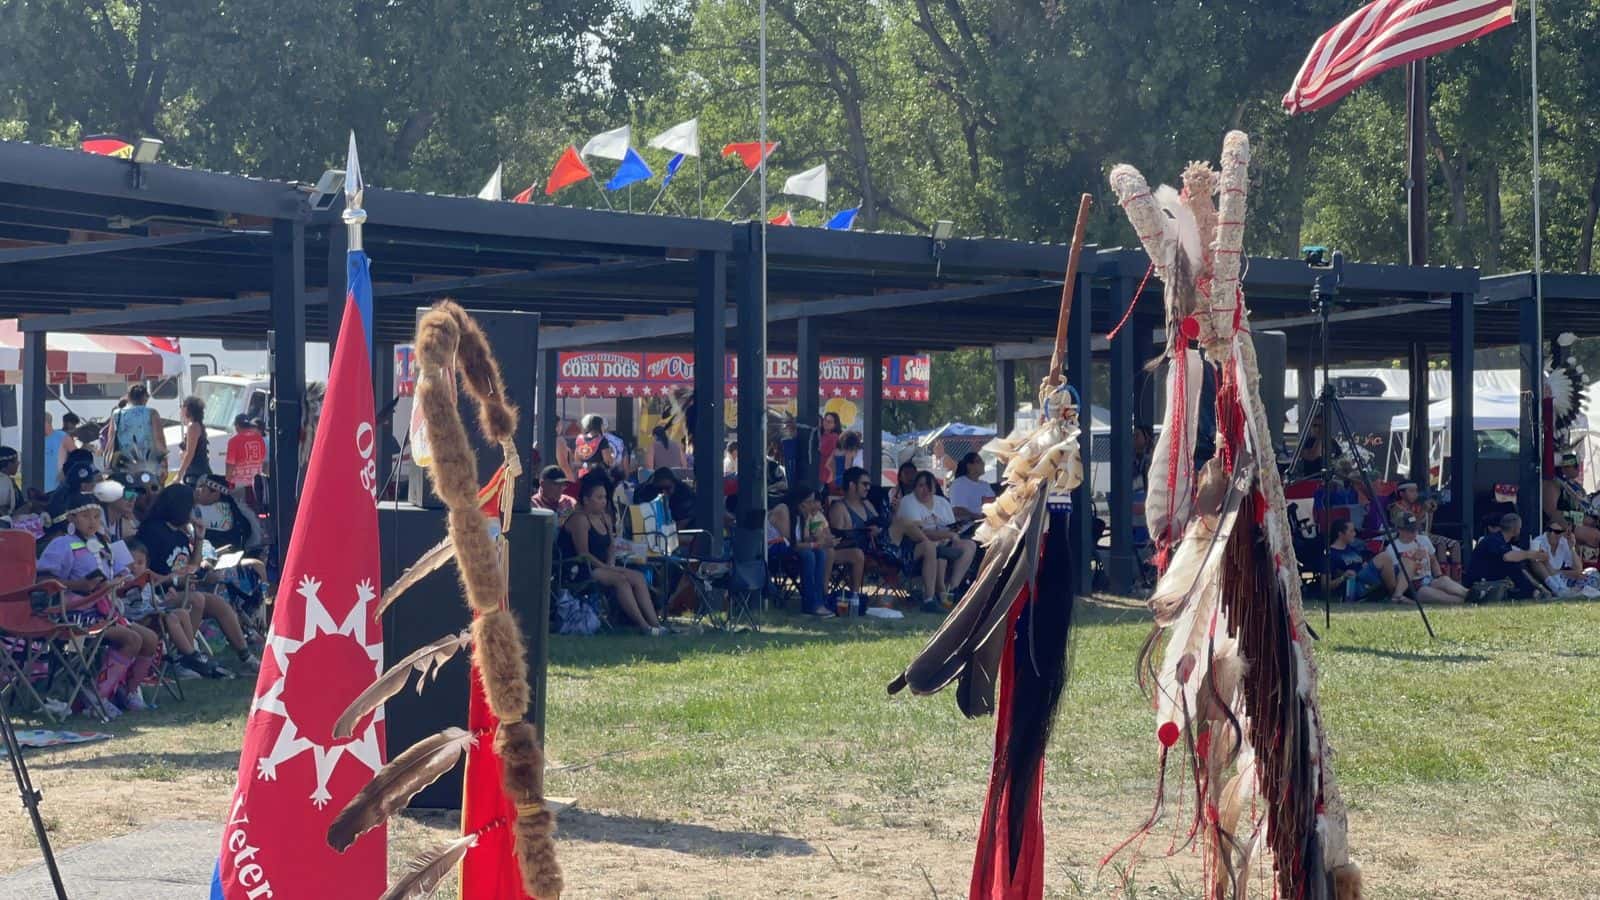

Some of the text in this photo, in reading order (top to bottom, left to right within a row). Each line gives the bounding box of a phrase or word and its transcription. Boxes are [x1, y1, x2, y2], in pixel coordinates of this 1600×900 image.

[562, 362, 599, 377] CORN
[603, 362, 640, 377] DOGS
[356, 422, 377, 506] Og
